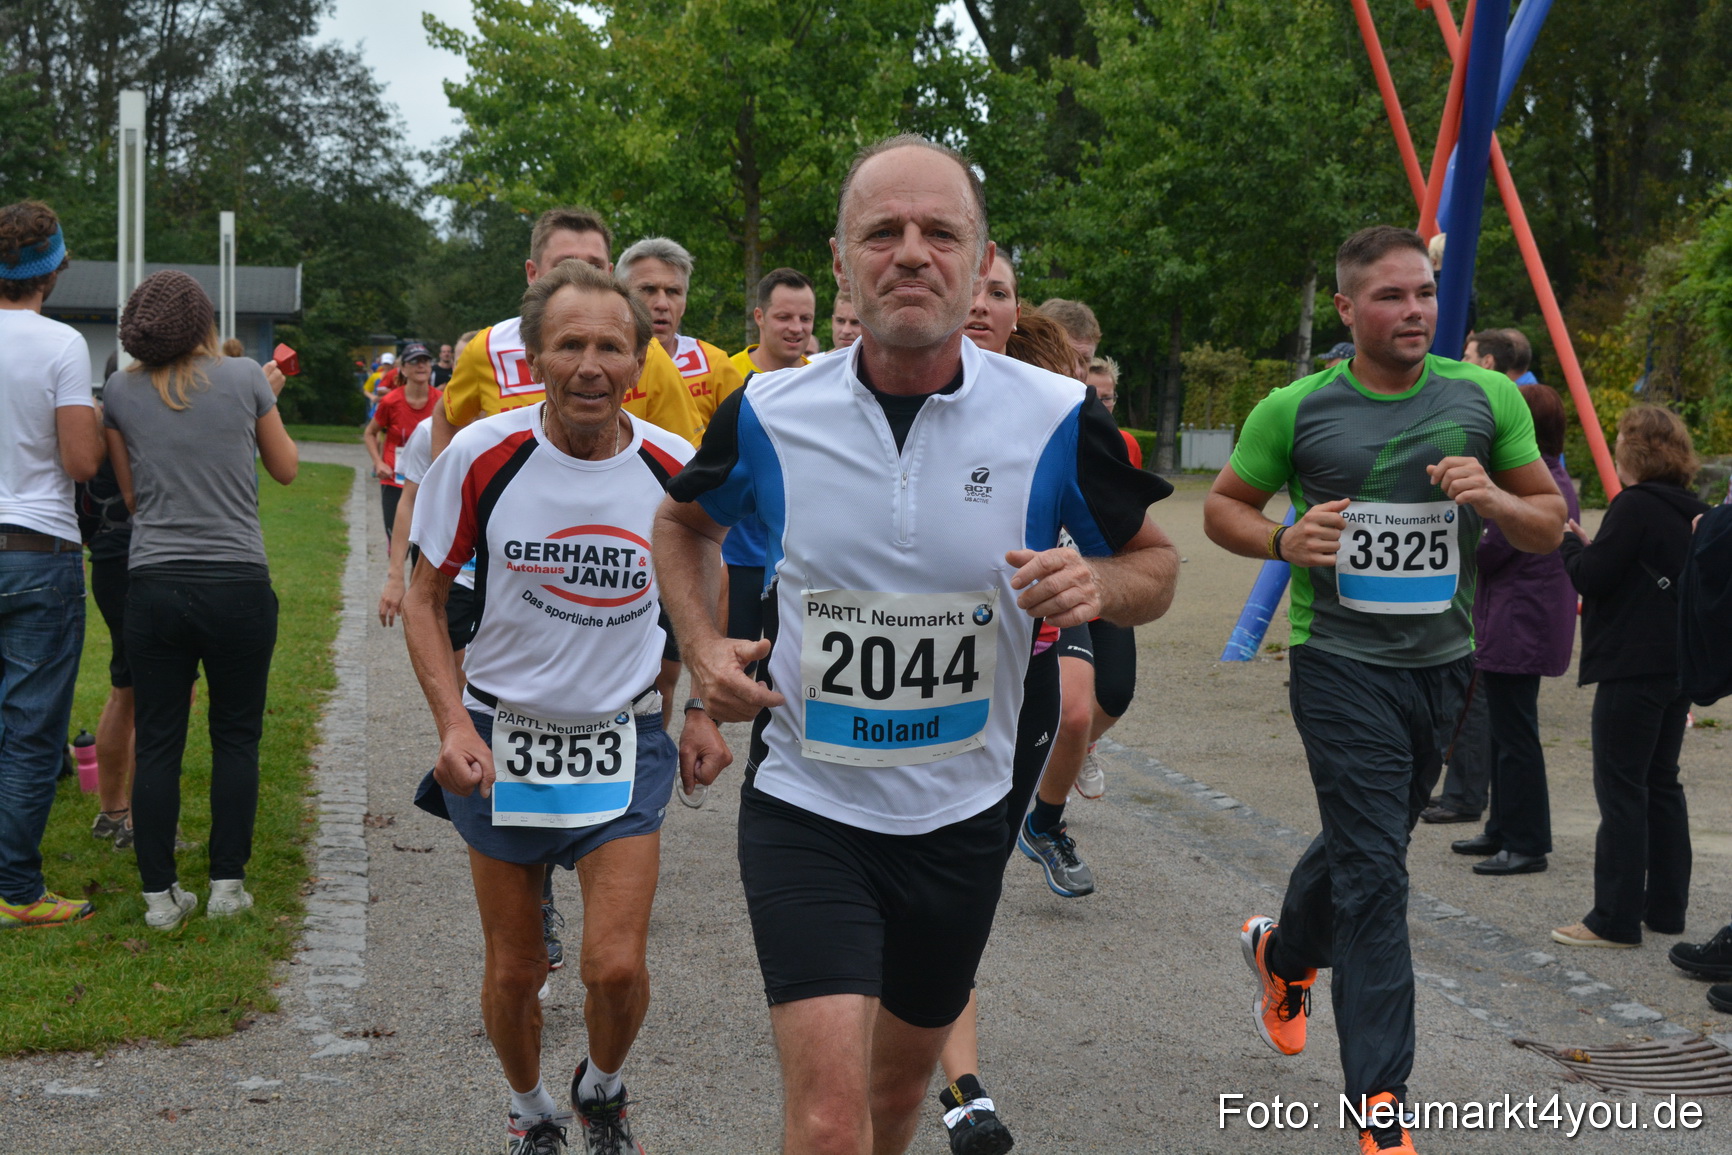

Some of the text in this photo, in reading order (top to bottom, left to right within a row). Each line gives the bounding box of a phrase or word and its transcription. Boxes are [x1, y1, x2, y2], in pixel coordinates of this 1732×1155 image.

[1342, 511, 1441, 525] PARTL Neumarkt
[504, 540, 647, 568] GERHART &
[1349, 529, 1449, 572] 3325
[506, 561, 565, 574] Autohaus
[521, 589, 653, 628] Das sportliche Autohaus
[807, 601, 965, 627] PARTL Neumarkt
[821, 630, 979, 701] 2044
[809, 687, 816, 698] D
[497, 710, 611, 735] PARTL Neumarkt
[852, 715, 940, 743] Roland
[506, 730, 623, 778] 3353
